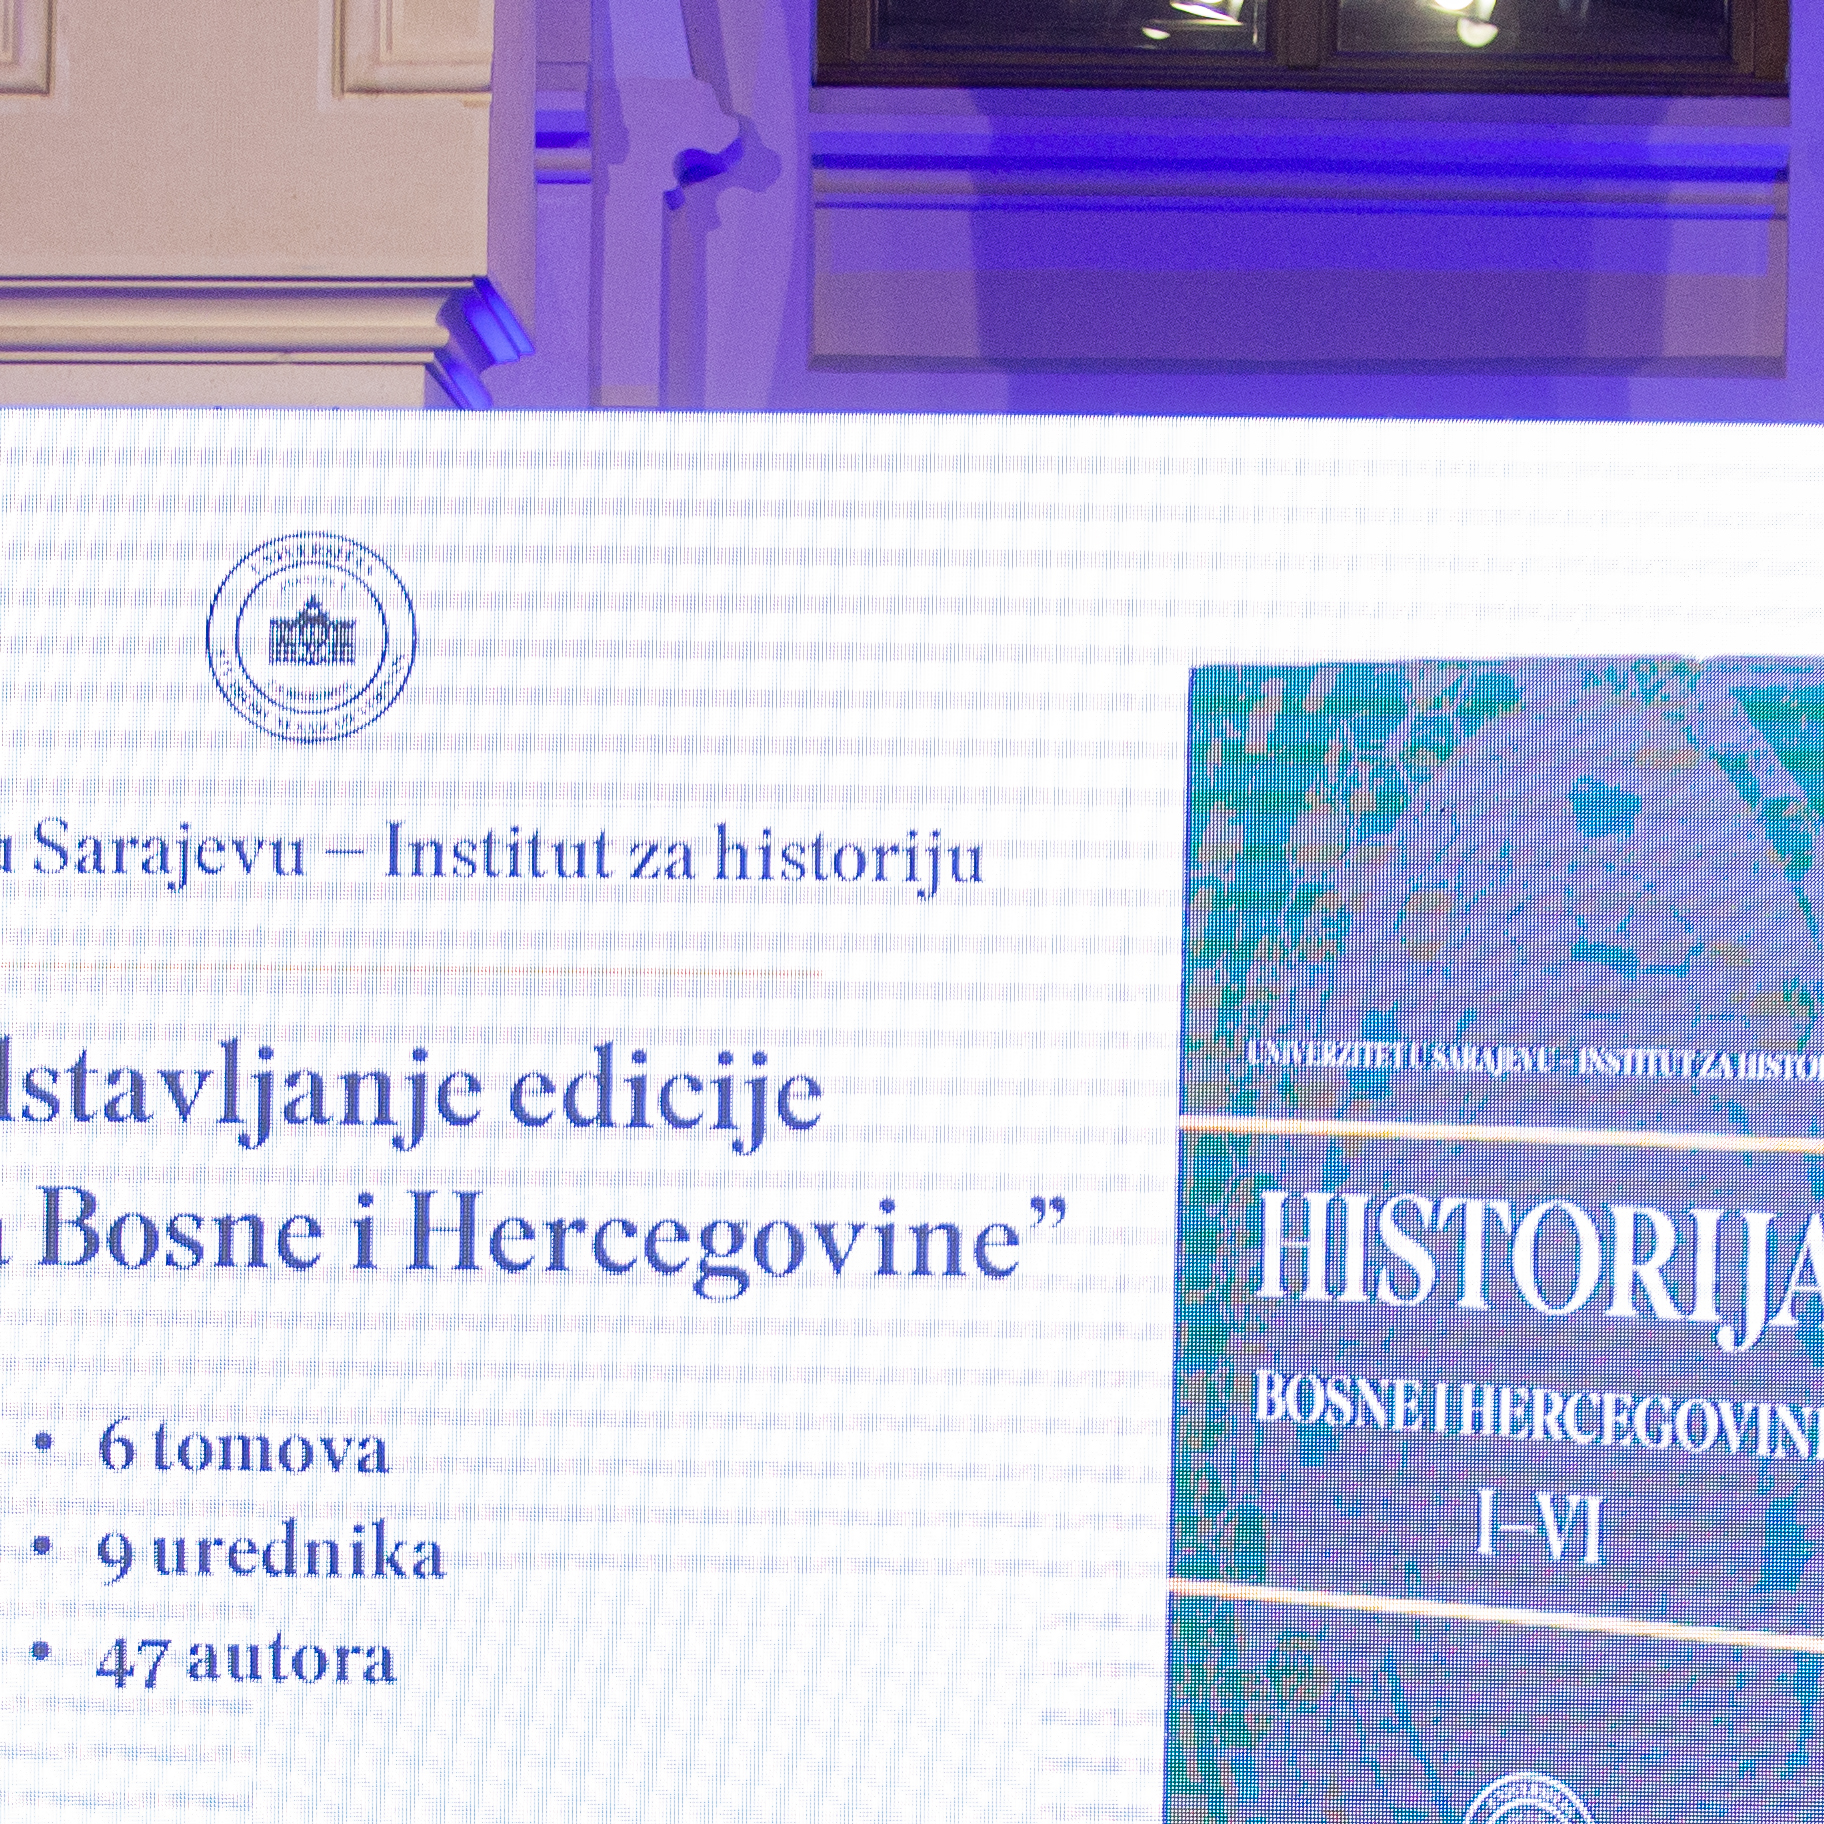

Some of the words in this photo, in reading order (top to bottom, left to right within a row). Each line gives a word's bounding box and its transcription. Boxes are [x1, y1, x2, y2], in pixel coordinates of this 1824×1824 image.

[33, 818, 307, 892] Sarajevu
[383, 819, 613, 879] Institut
[627, 842, 694, 879] za
[713, 822, 985, 900] historiju
[1246, 1039, 1404, 1070] UNIVERZITET
[1409, 1043, 1428, 1070] U
[1432, 1045, 1556, 1077] SARAJEVU
[1578, 1047, 1698, 1079] INSTITUT
[1699, 1051, 1735, 1080] ZA
[507, 1040, 823, 1155] edicije
[37, 1185, 324, 1272] Bosne
[351, 1189, 376, 1271] i
[406, 1189, 1069, 1302] Hercegovine”
[1255, 1367, 1421, 1434] BOSNE
[1434, 1381, 1448, 1433] I
[97, 1416, 137, 1470] 6
[152, 1424, 390, 1476] tomova
[95, 1531, 135, 1586] 9
[152, 1517, 446, 1580] urednika
[95, 1633, 171, 1690] 47
[185, 1634, 397, 1686] autora
